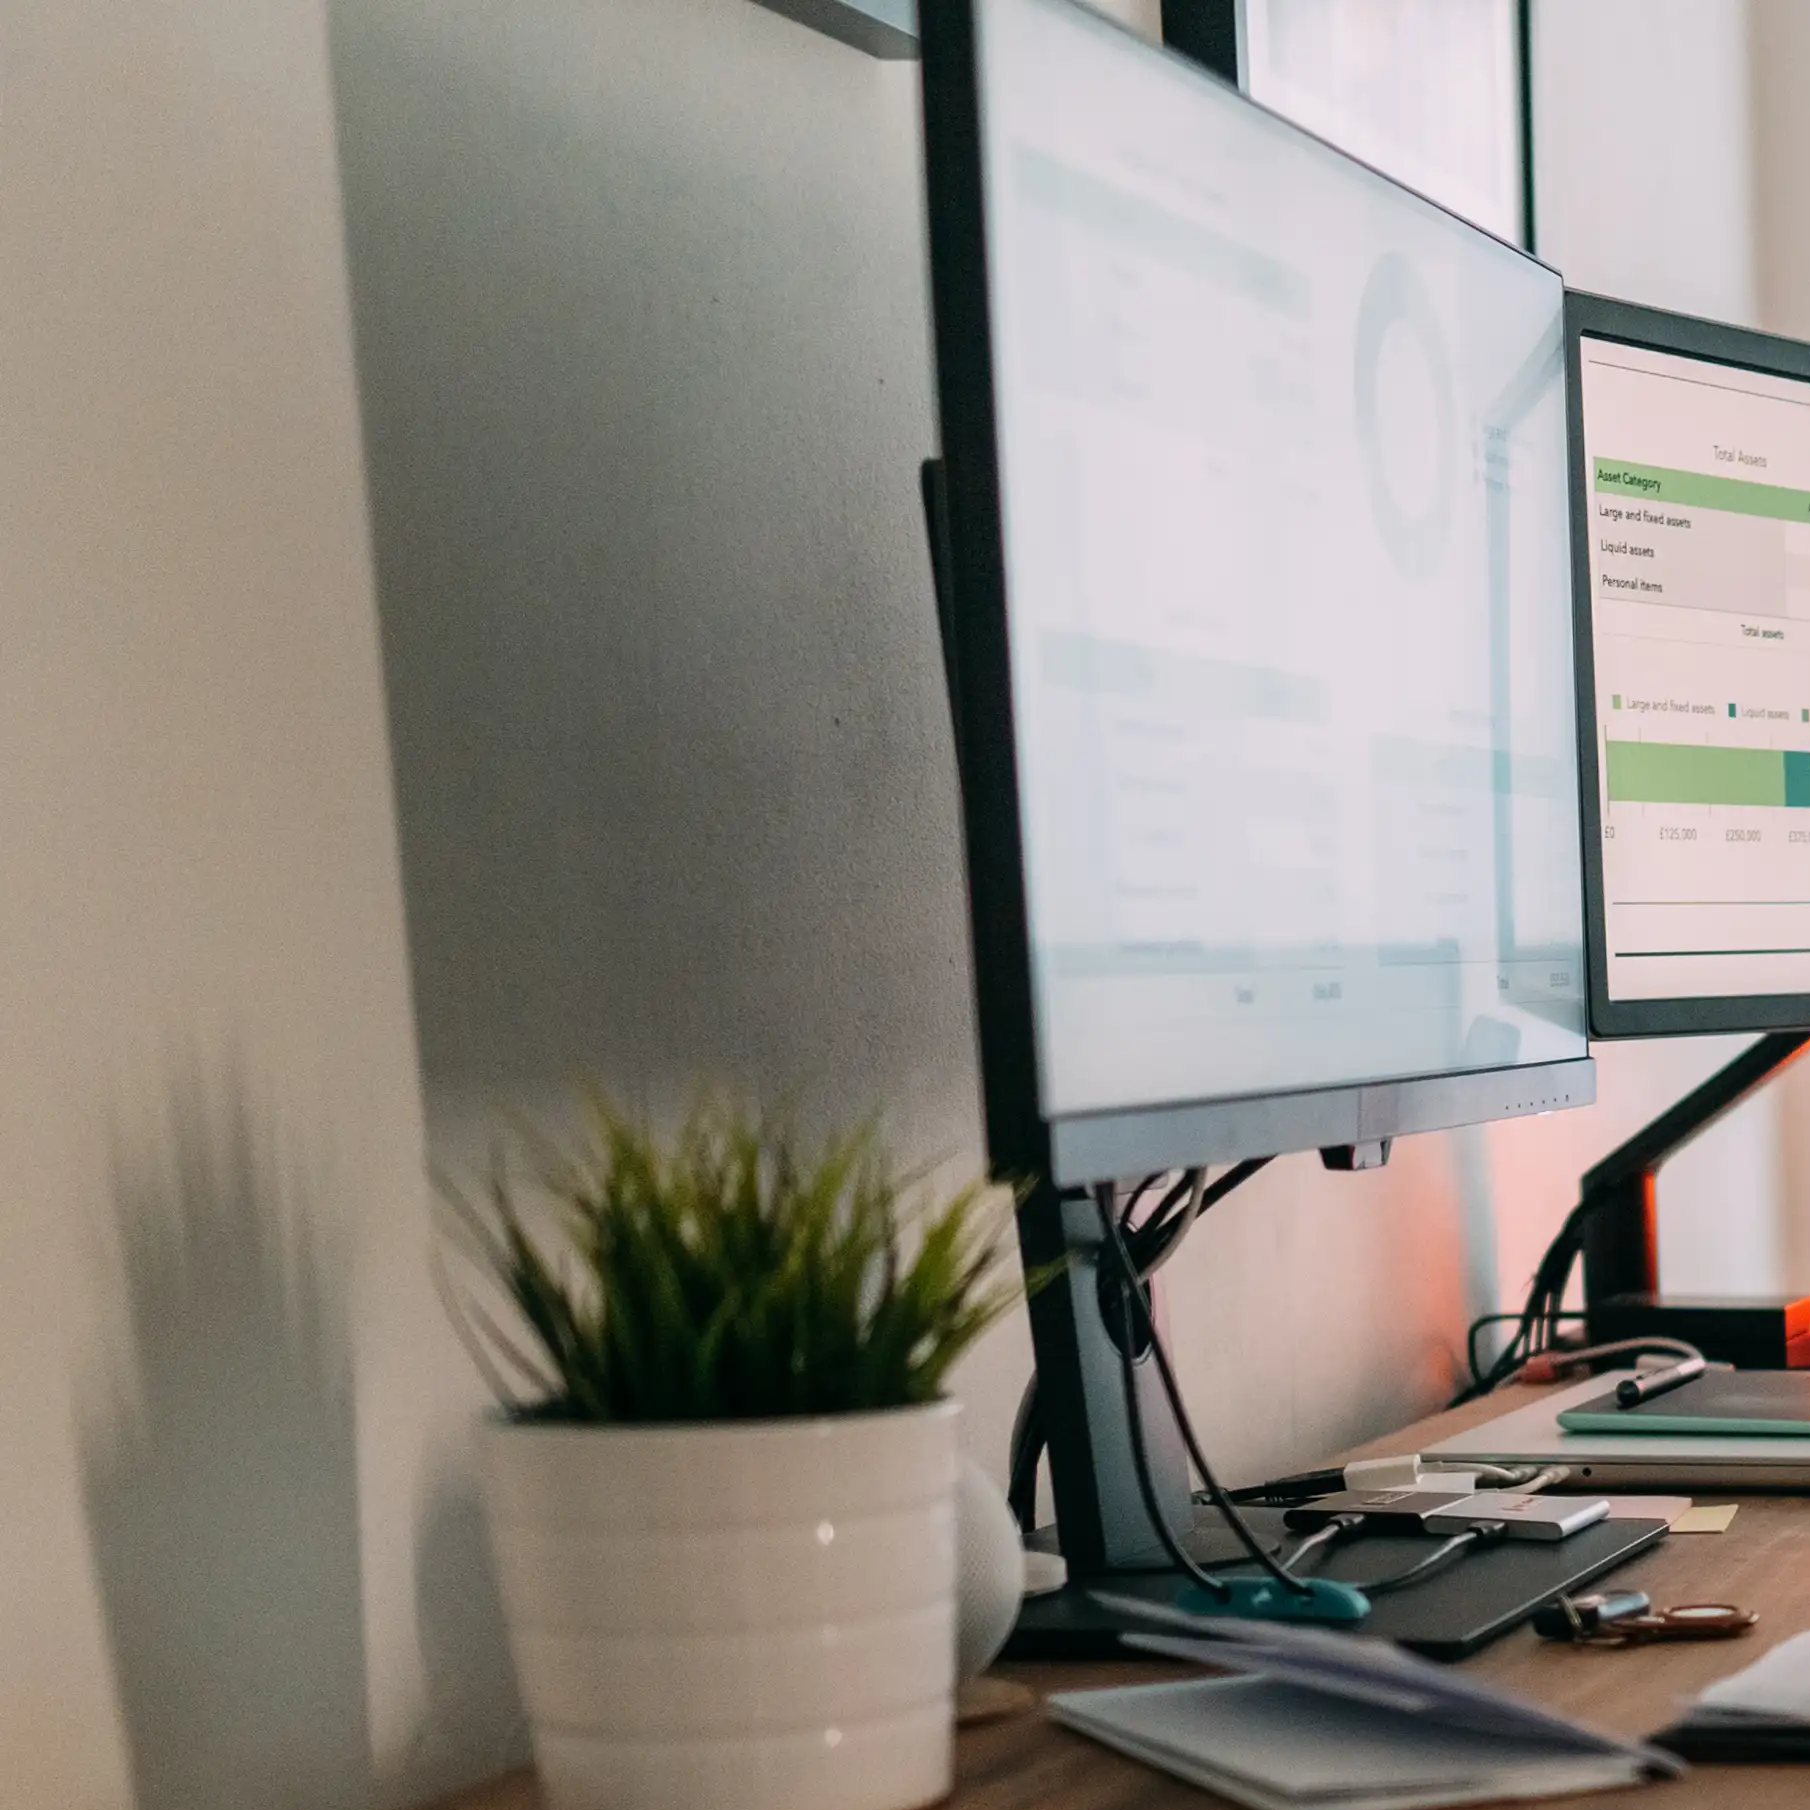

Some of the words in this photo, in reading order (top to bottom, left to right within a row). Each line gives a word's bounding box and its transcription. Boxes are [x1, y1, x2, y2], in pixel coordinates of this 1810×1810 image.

[1713, 445, 1736, 463] Total
[1738, 450, 1768, 468] Assets
[1597, 469, 1621, 484] Asset
[1623, 471, 1662, 493] Category
[1599, 504, 1624, 522] Large
[1625, 507, 1642, 523] and
[1643, 509, 1665, 526] fixed
[1666, 514, 1692, 529] assets
[1600, 539, 1628, 557] Liquid
[1629, 544, 1655, 558] assets
[1602, 573, 1639, 590] Personal
[1640, 578, 1663, 593] items
[1740, 623, 1760, 638] Total
[1761, 628, 1785, 641] assets
[1626, 696, 1651, 712] Large
[1652, 698, 1668, 713] and
[1669, 698, 1690, 714] fixed
[1691, 702, 1716, 716] assets
[1604, 826, 1616, 840] £0
[1659, 827, 1698, 842] £125,000
[1725, 829, 1762, 843] £250,000
